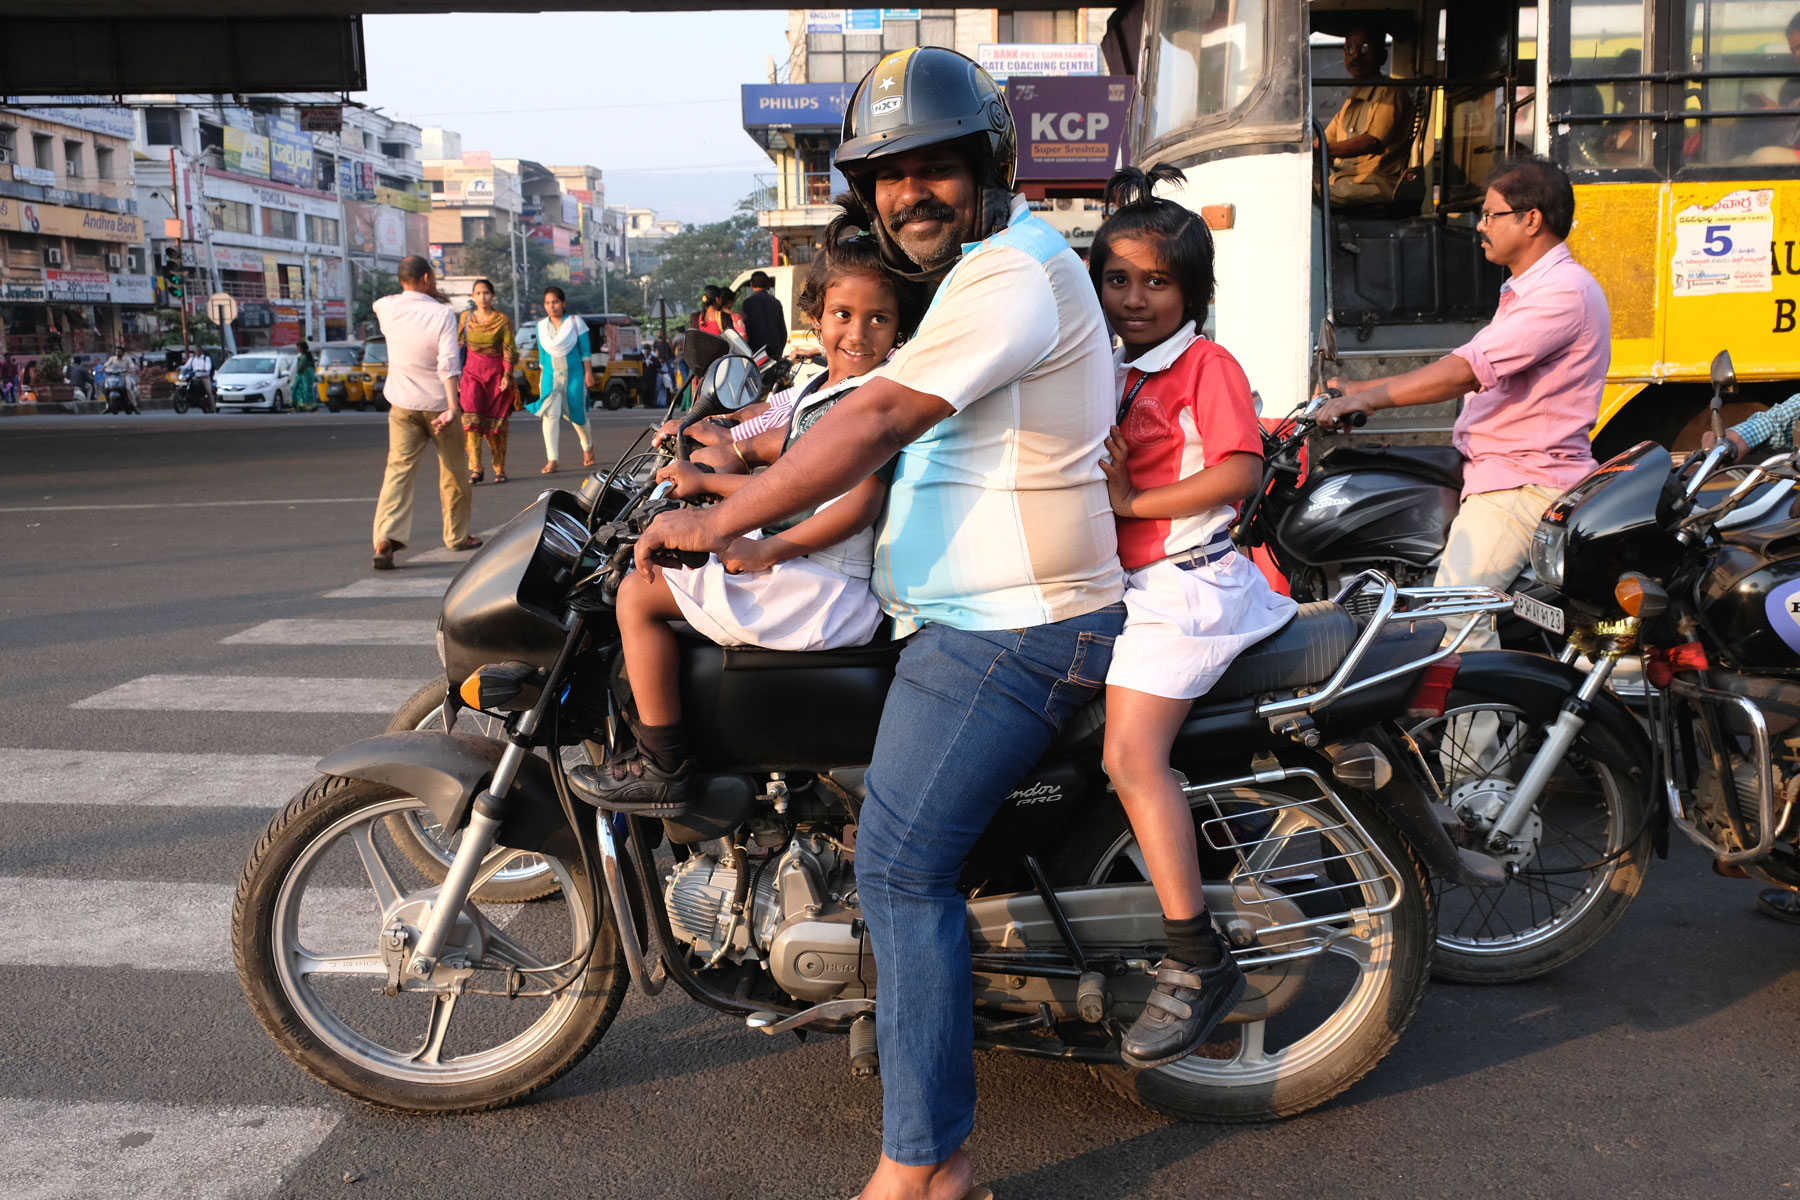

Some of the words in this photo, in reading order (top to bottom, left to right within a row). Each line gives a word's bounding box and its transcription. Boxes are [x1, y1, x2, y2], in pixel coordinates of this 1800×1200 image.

[809, 11, 841, 20] ENGLISH
[993, 49, 1018, 59] BANK
[982, 61, 1005, 71] GATE
[1007, 61, 1057, 71] COACHING
[1060, 61, 1094, 71] CENTRE
[759, 97, 819, 110] PHILIPS
[874, 100, 899, 112] NXT
[1031, 112, 1110, 141] KCP
[1034, 145, 1061, 155] Super
[1065, 145, 1106, 154] Sreshtaa
[83, 213, 115, 231] Andhra
[117, 217, 137, 233] Bank
[1308, 498, 1351, 511] HONDA
[1016, 794, 1062, 806] PRO
[826, 963, 856, 972] Hero
[280, 1016, 312, 1051] apollo
